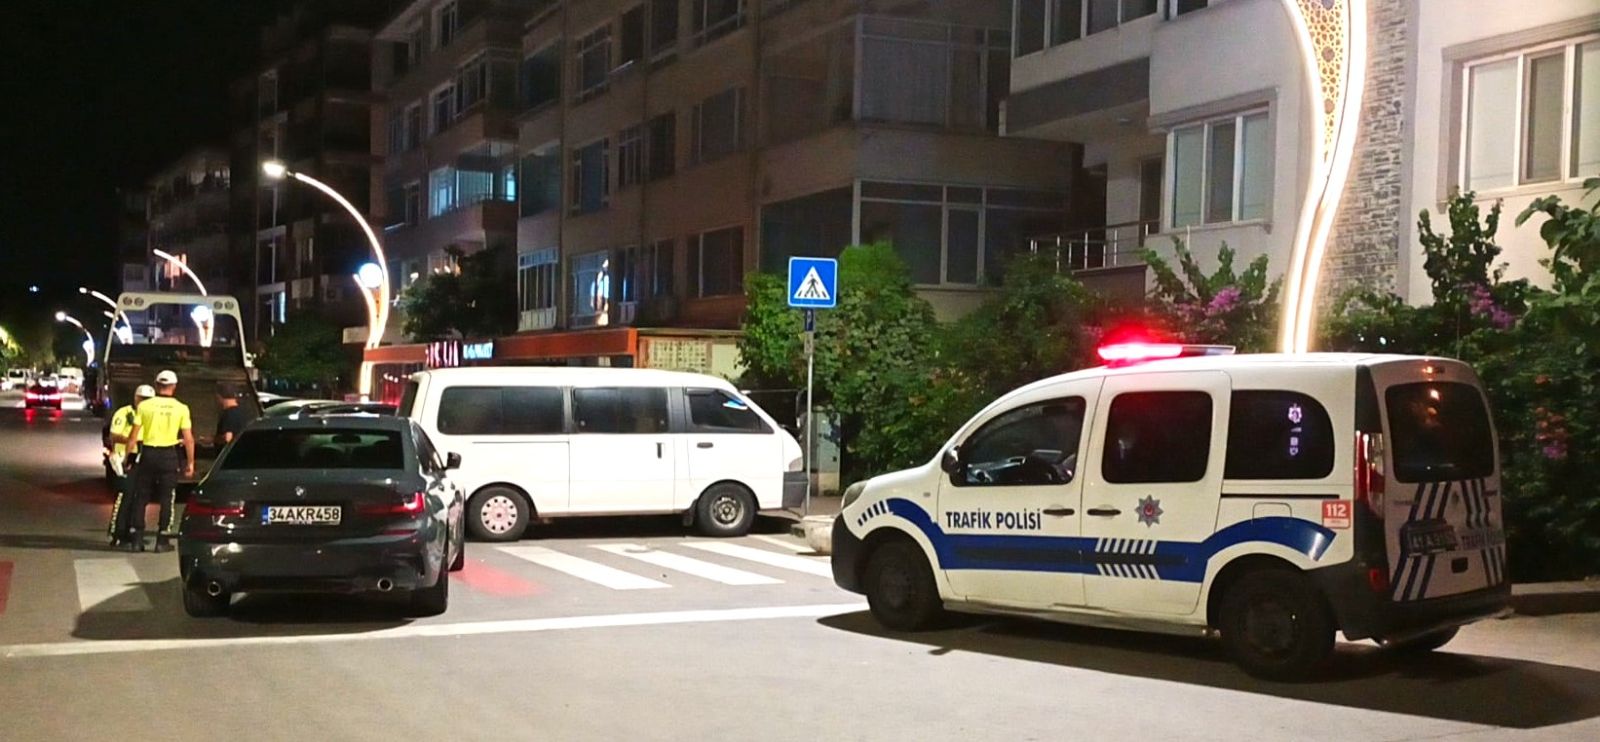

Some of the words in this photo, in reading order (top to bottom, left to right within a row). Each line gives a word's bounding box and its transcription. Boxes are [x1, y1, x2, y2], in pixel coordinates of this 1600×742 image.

[269, 508, 340, 521] 34AKR458
[1326, 503, 1347, 517] 112
[945, 507, 992, 529] TRAFİK
[996, 508, 1041, 530] POLİSİ
